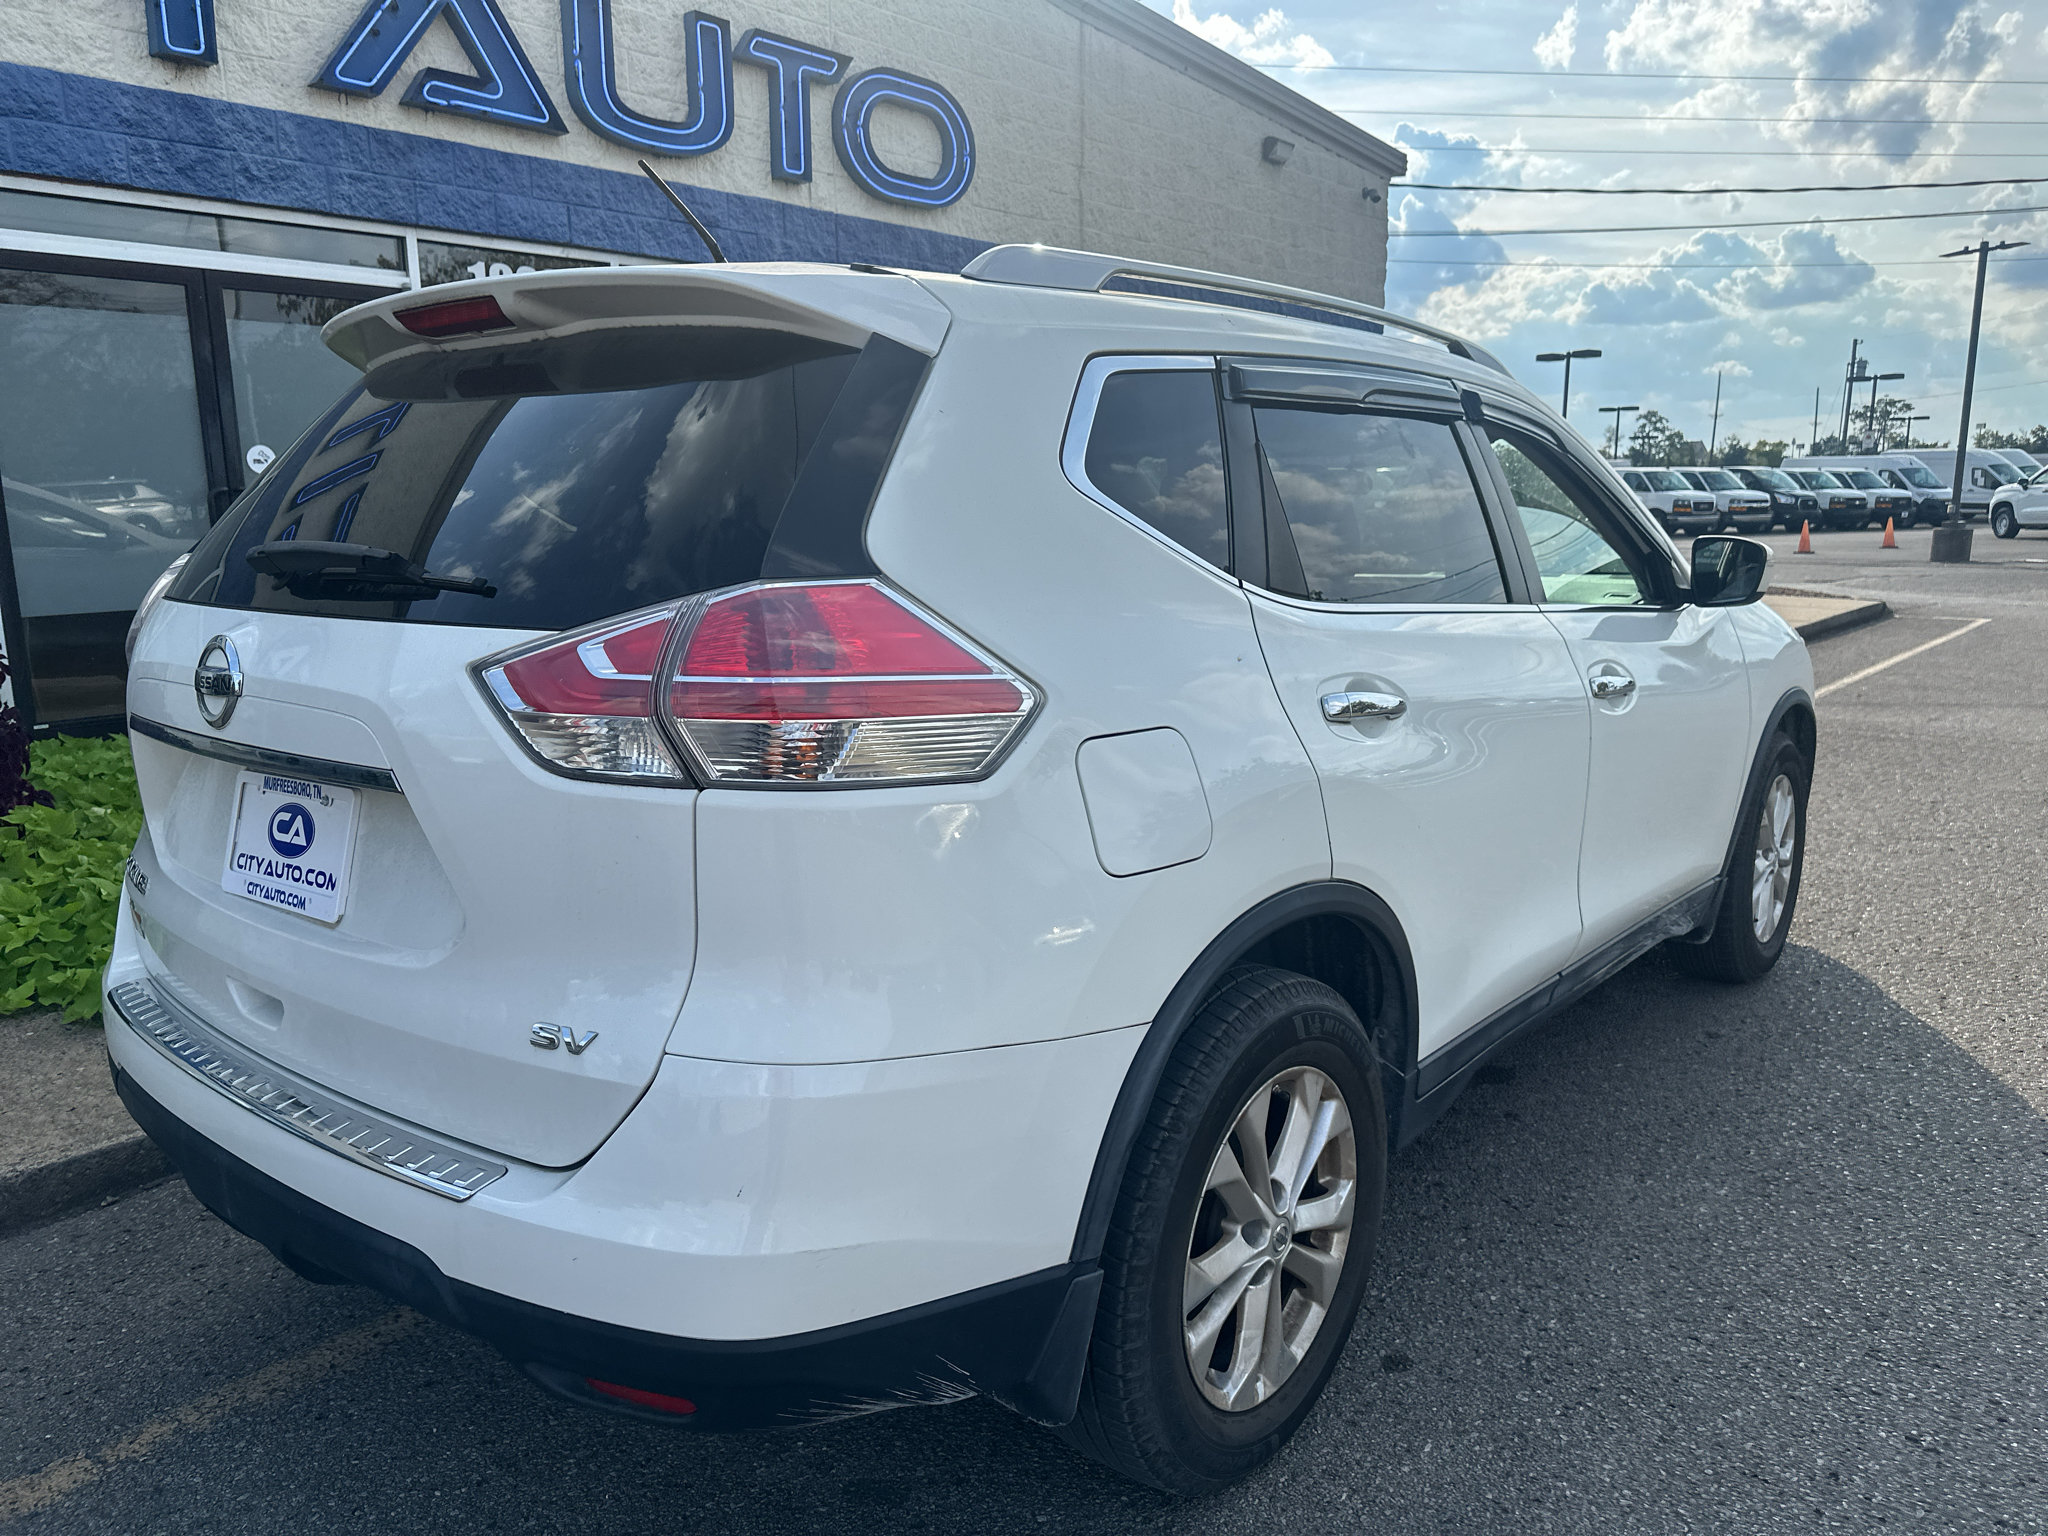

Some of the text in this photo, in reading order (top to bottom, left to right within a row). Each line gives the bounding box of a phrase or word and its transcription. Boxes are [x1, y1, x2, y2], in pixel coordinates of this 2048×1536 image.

[308, 0, 976, 208] AUTO
[263, 776, 322, 800] MURFREESBORO, TN
[272, 811, 307, 847] CA
[247, 881, 306, 911] CITYAUTO.COM
[529, 1021, 599, 1055] SV
